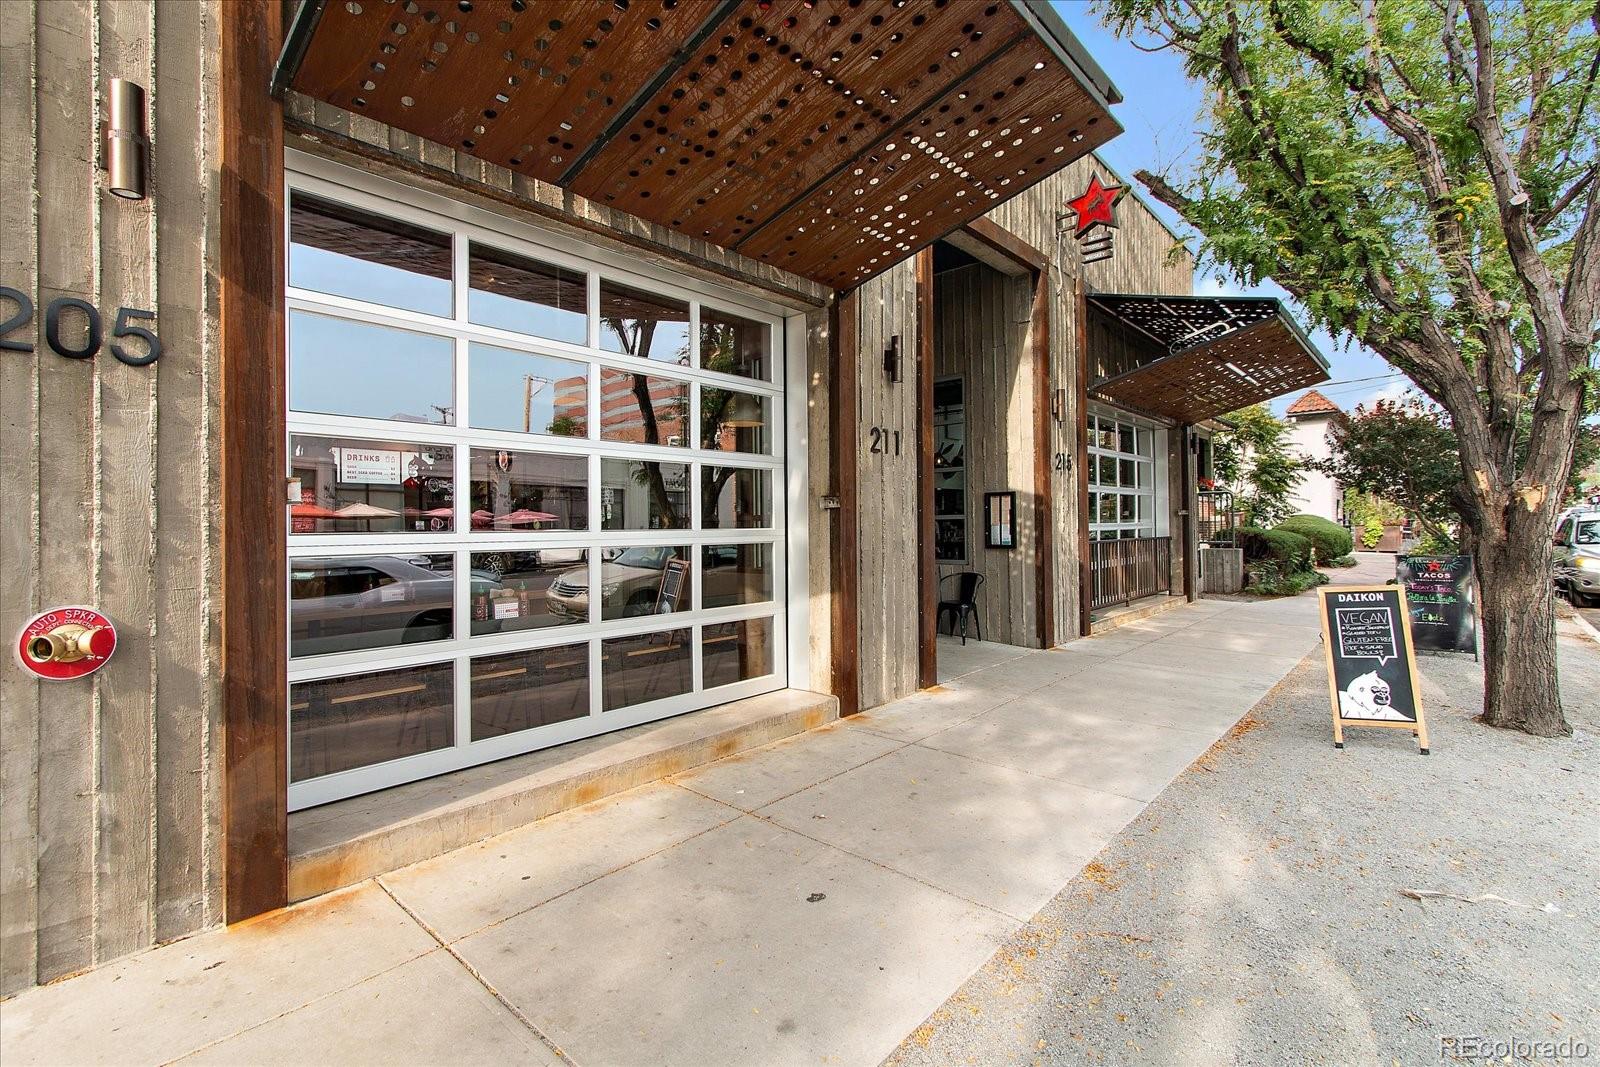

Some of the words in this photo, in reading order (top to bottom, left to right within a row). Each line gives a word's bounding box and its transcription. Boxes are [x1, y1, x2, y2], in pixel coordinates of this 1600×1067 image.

[0, 286, 161, 367] 205
[870, 427, 900, 456] 211
[347, 454, 380, 462] DRINKS
[1055, 452, 1073, 472] 215
[1338, 592, 1384, 603] DAIKON
[28, 613, 57, 637] AUTO
[64, 610, 97, 623] SPKR
[1340, 611, 1389, 624] VEGAN
